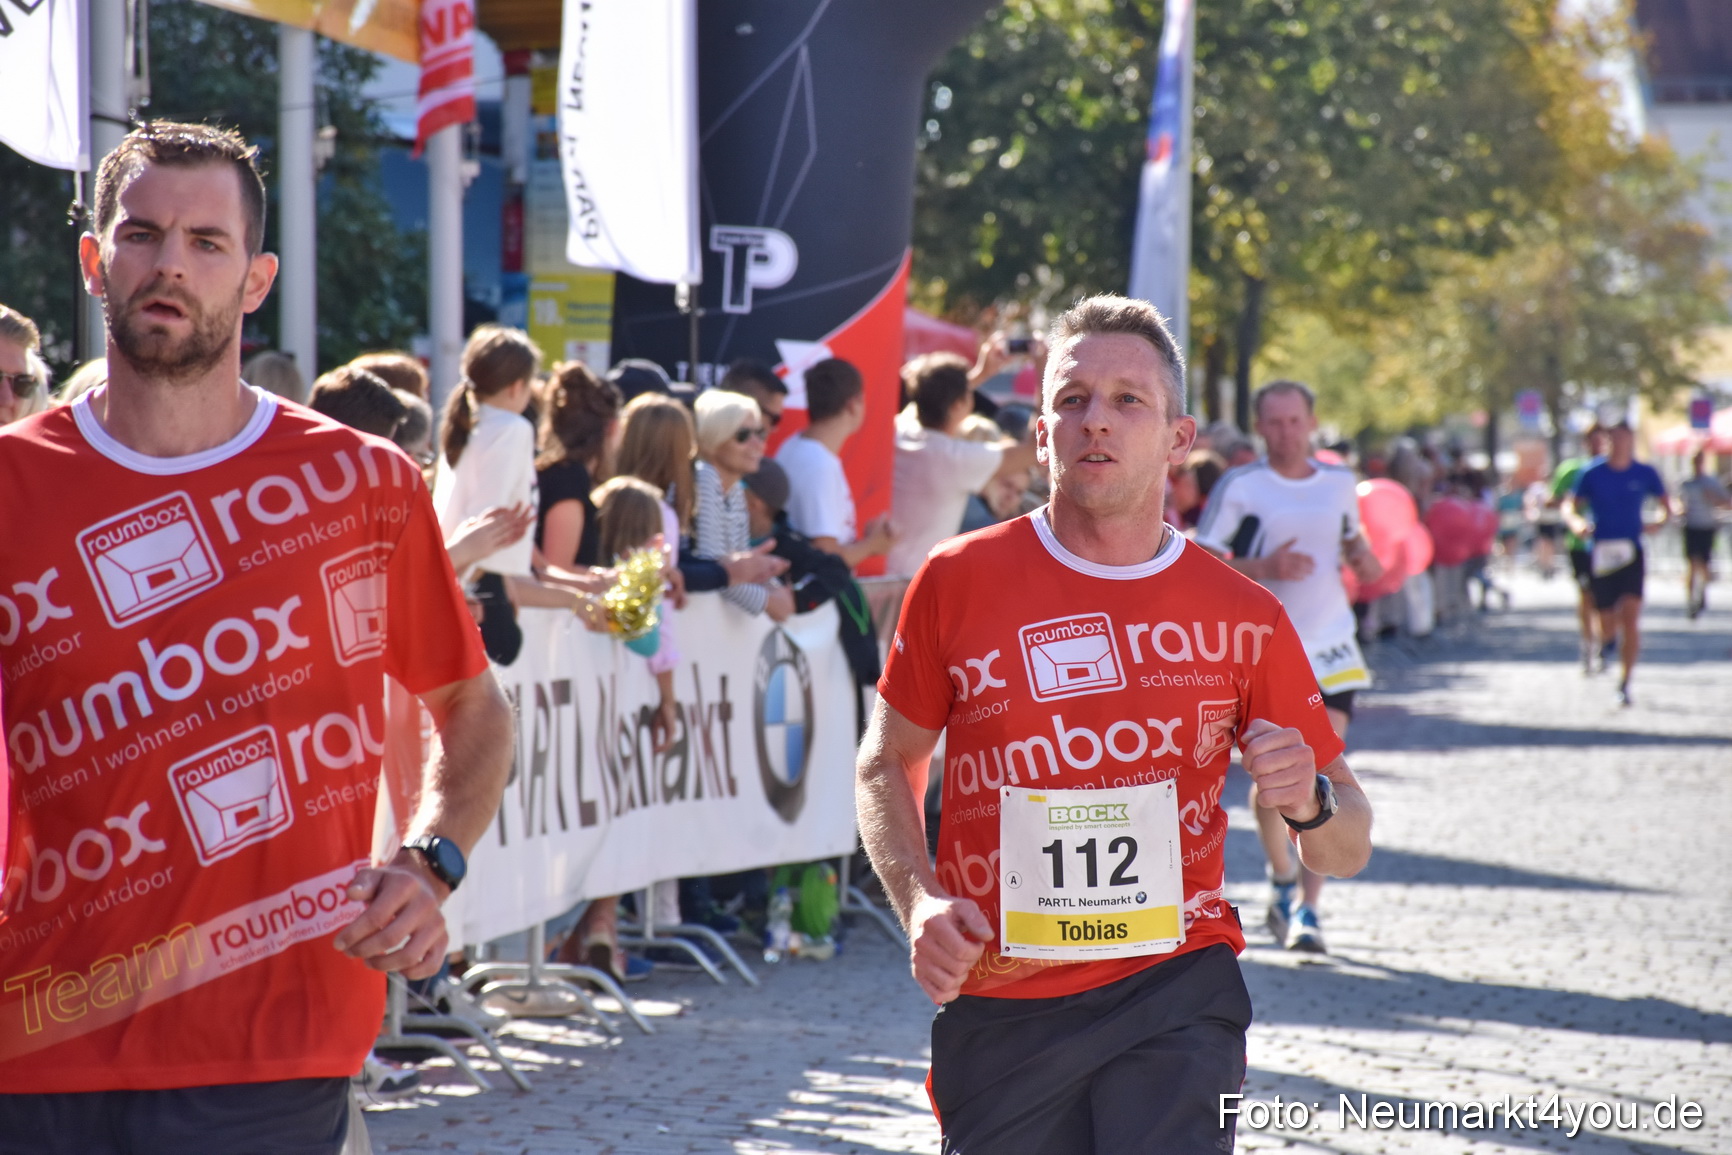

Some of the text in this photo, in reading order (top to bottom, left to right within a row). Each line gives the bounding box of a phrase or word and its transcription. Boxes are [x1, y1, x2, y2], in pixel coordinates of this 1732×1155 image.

[85, 502, 187, 556] raumbox
[238, 513, 357, 572] schenken
[1026, 621, 1106, 646] raumbox
[8, 594, 310, 778] aumbox
[1140, 669, 1229, 689] schenken
[105, 711, 201, 771] wohnen
[221, 661, 314, 716] outdoor
[177, 735, 272, 793] raumbox
[949, 714, 1183, 799] raumbox
[1048, 803, 1129, 824] BOCK
[1104, 821, 1131, 829] concepts
[1010, 875, 1017, 885] A
[1042, 836, 1139, 889] 112
[82, 866, 174, 919] outdoor
[1038, 895, 1132, 908] PARTL Neumarkt
[1057, 919, 1128, 941] Tobias
[4, 921, 204, 1036] Team
